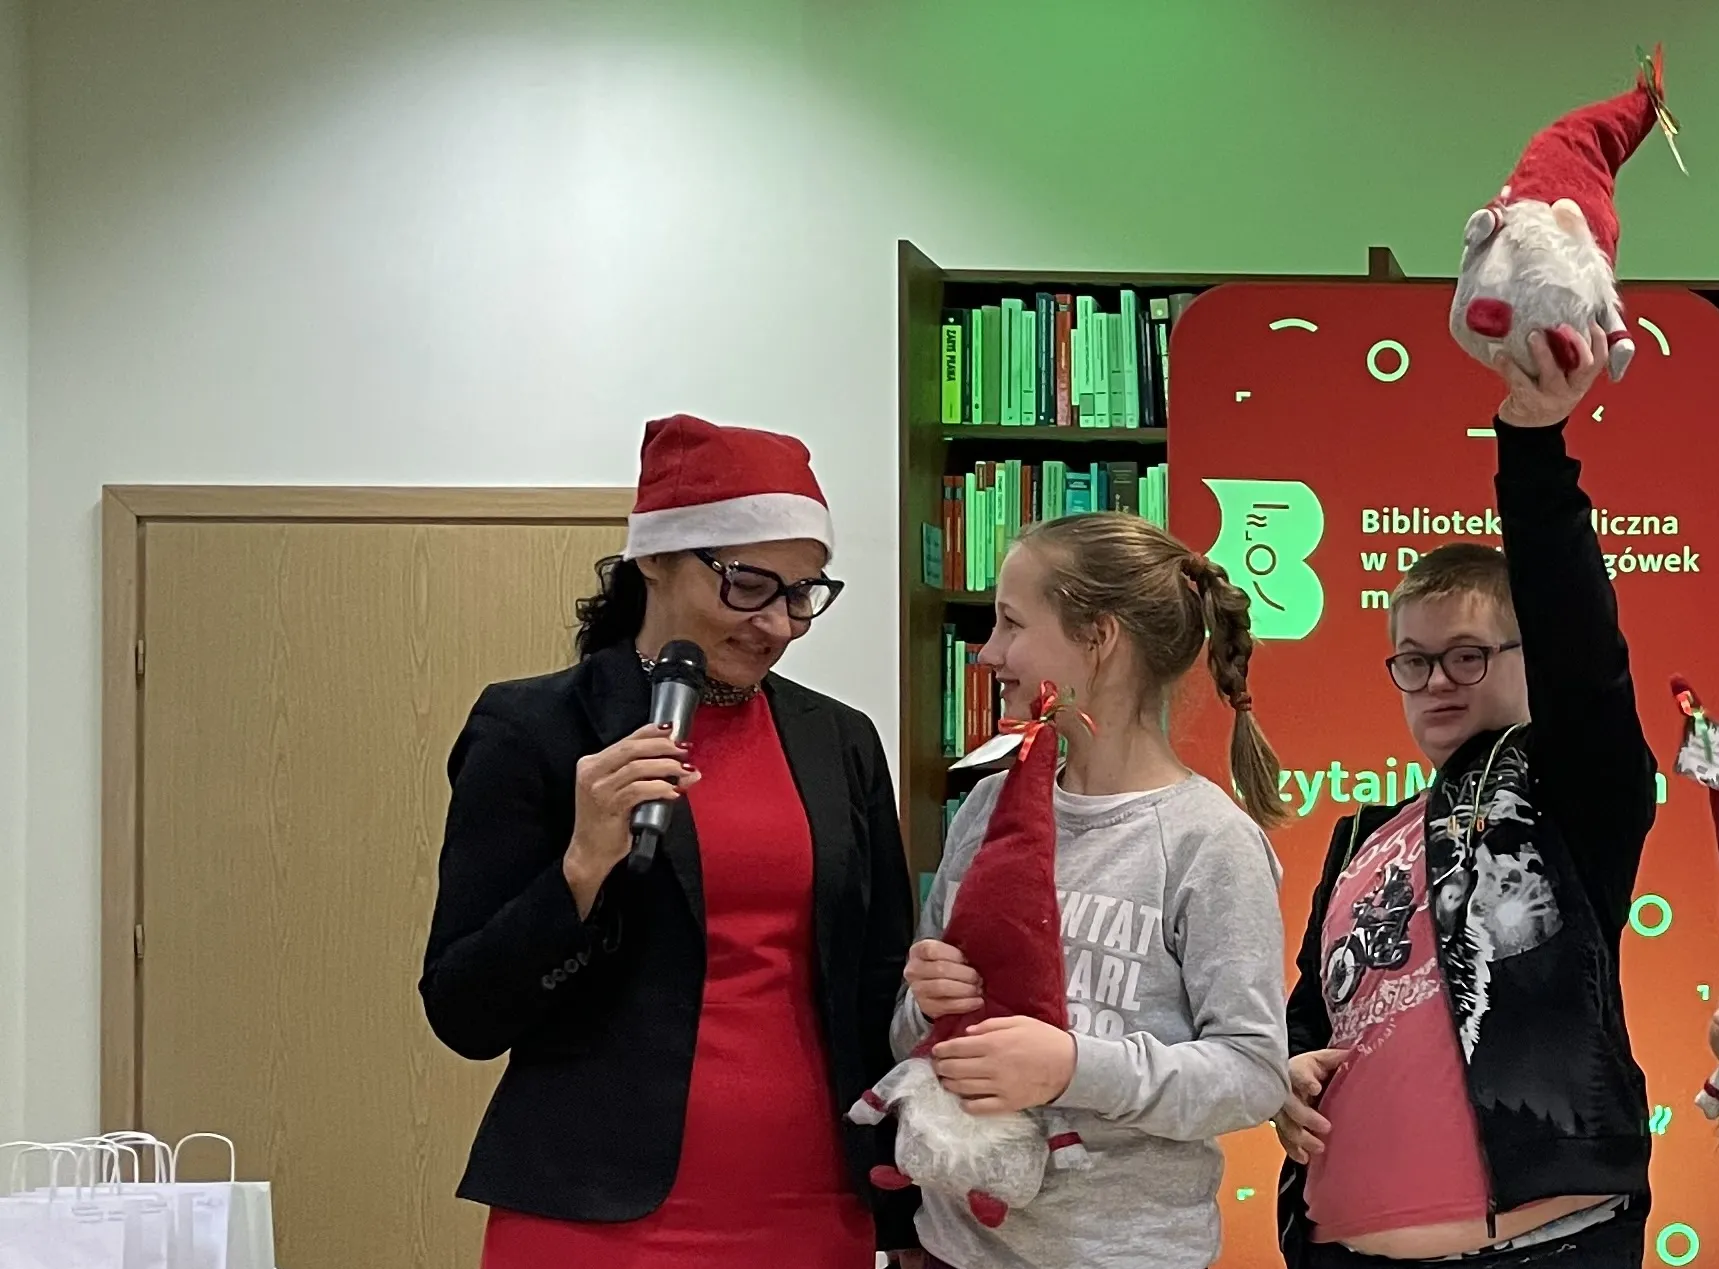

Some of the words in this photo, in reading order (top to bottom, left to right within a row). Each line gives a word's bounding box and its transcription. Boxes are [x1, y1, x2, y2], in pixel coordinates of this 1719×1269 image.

[1361, 507, 1503, 535] Bibliotek
[1590, 508, 1679, 536] liczna
[1360, 552, 1388, 571] w
[1602, 546, 1701, 580] gówek
[1057, 890, 1163, 956] NTAT
[1064, 946, 1142, 1011] ARL
